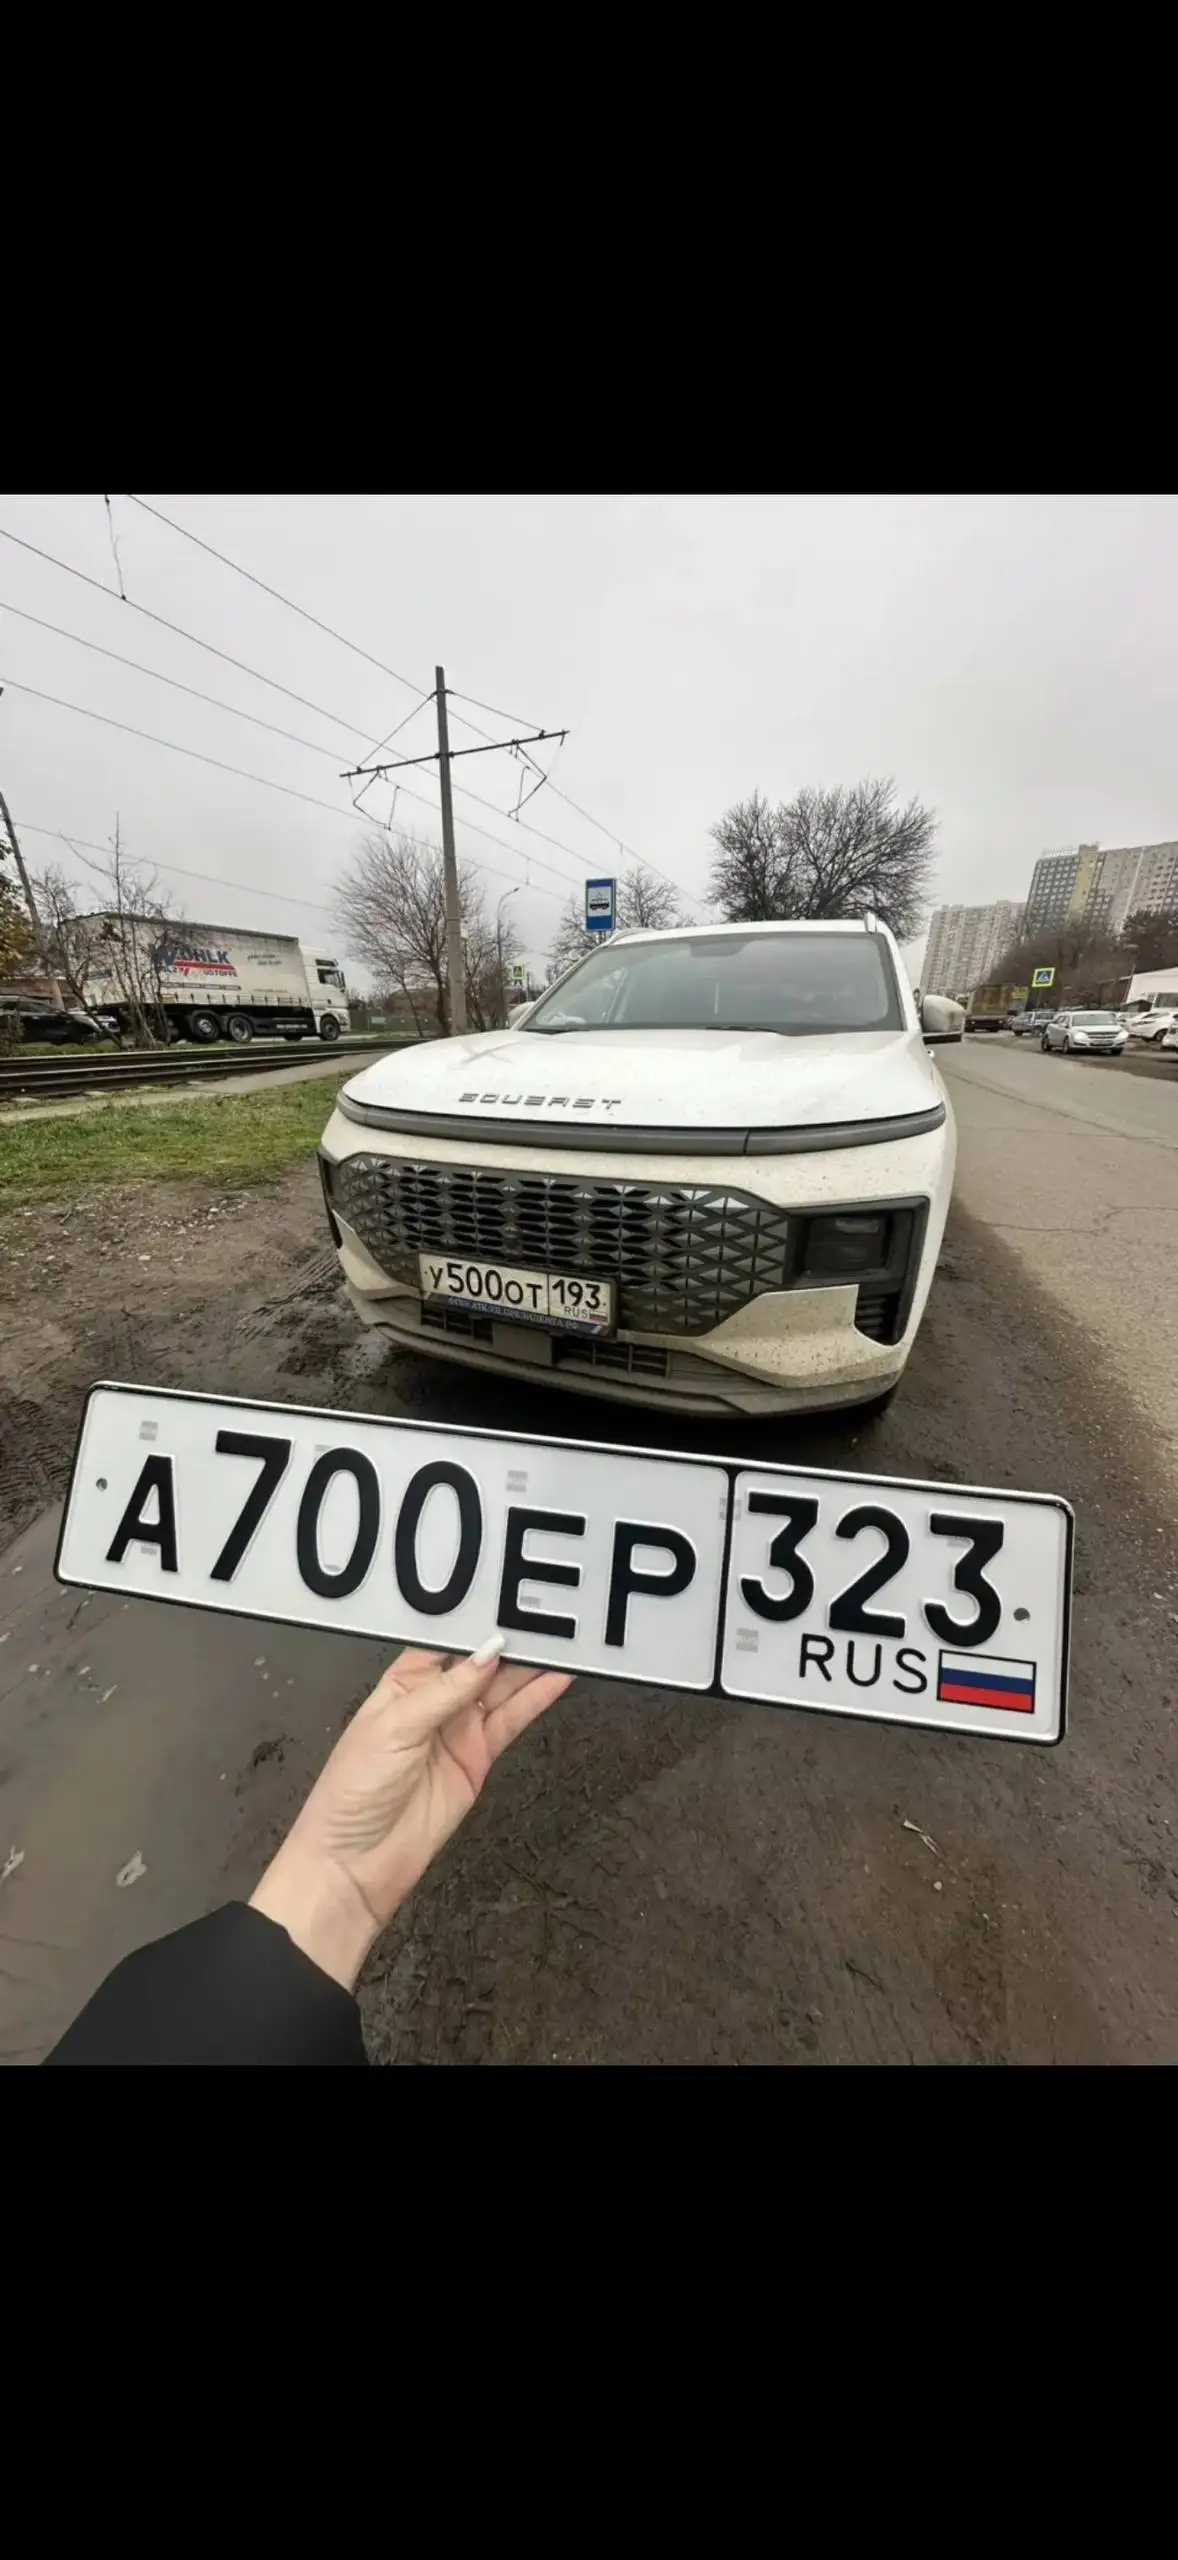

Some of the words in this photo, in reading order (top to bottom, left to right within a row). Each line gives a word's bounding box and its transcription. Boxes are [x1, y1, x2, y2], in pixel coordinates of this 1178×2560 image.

[458, 1093, 622, 1110] SOUEAST
[429, 1262, 542, 1309] У500ОТ
[551, 1278, 601, 1310] 193
[563, 1306, 589, 1320] RUS
[105, 1429, 697, 1649] А700ЕР
[740, 1491, 1005, 1648] 323
[799, 1632, 929, 1695] RUS
